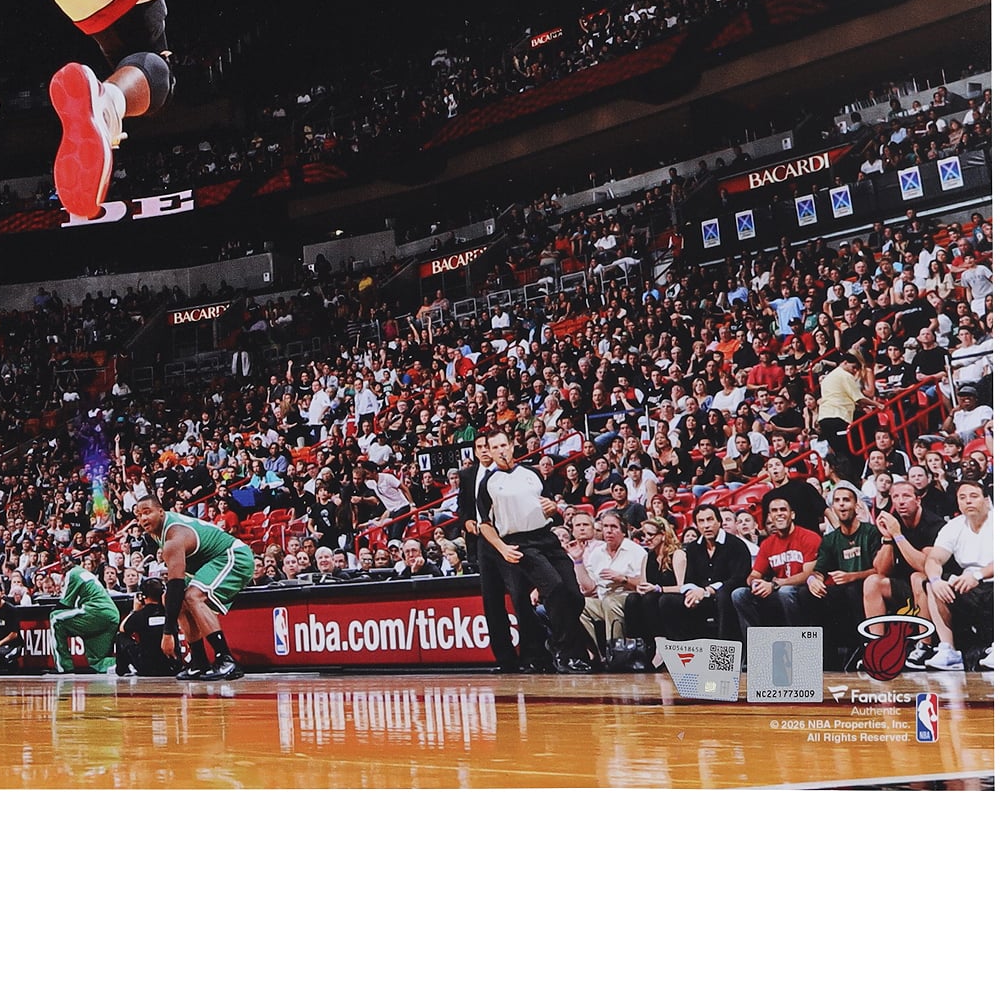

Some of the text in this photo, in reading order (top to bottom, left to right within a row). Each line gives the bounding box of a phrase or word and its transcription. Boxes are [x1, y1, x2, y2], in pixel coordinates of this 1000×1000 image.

[748, 152, 831, 189] BACARDI
[294, 607, 519, 652] nba.com/tickes
[801, 631, 818, 639] KBH
[756, 690, 815, 698] NC221773009
